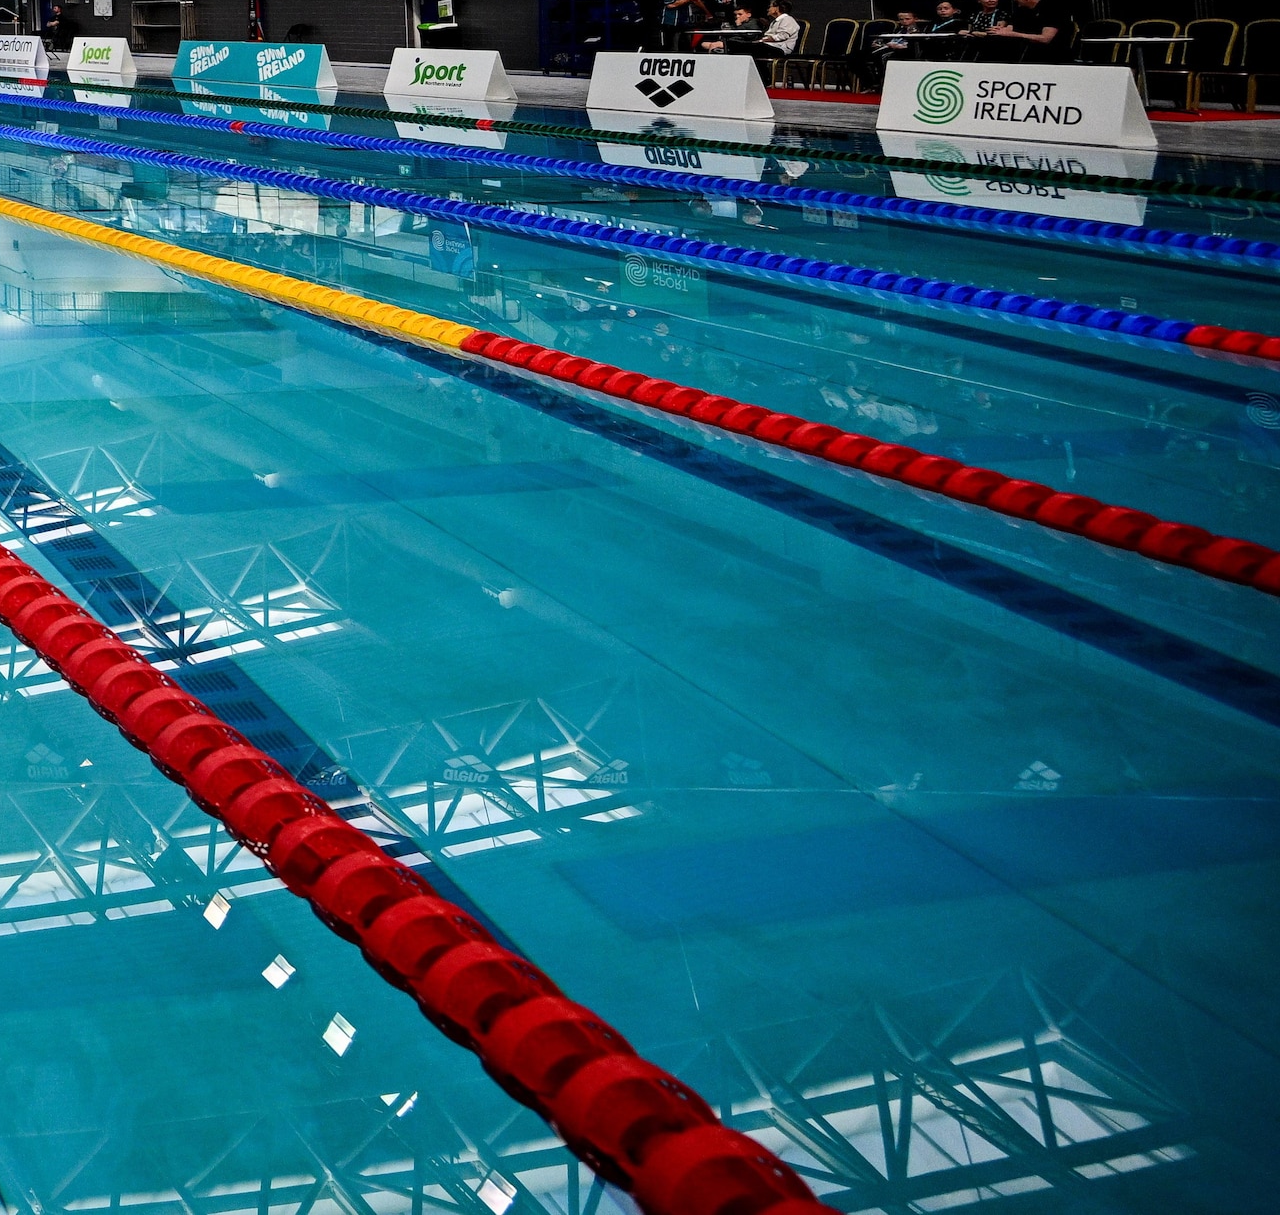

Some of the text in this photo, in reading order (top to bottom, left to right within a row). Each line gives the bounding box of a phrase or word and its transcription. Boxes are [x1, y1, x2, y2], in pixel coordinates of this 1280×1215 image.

[190, 44, 214, 63] SWIM
[190, 46, 230, 77] IRELAND
[256, 46, 287, 67] SWIM
[258, 48, 306, 82] IRELAND
[640, 58, 696, 78] arena
[976, 80, 1057, 101] SPORT
[974, 101, 1083, 125] IRELAND
